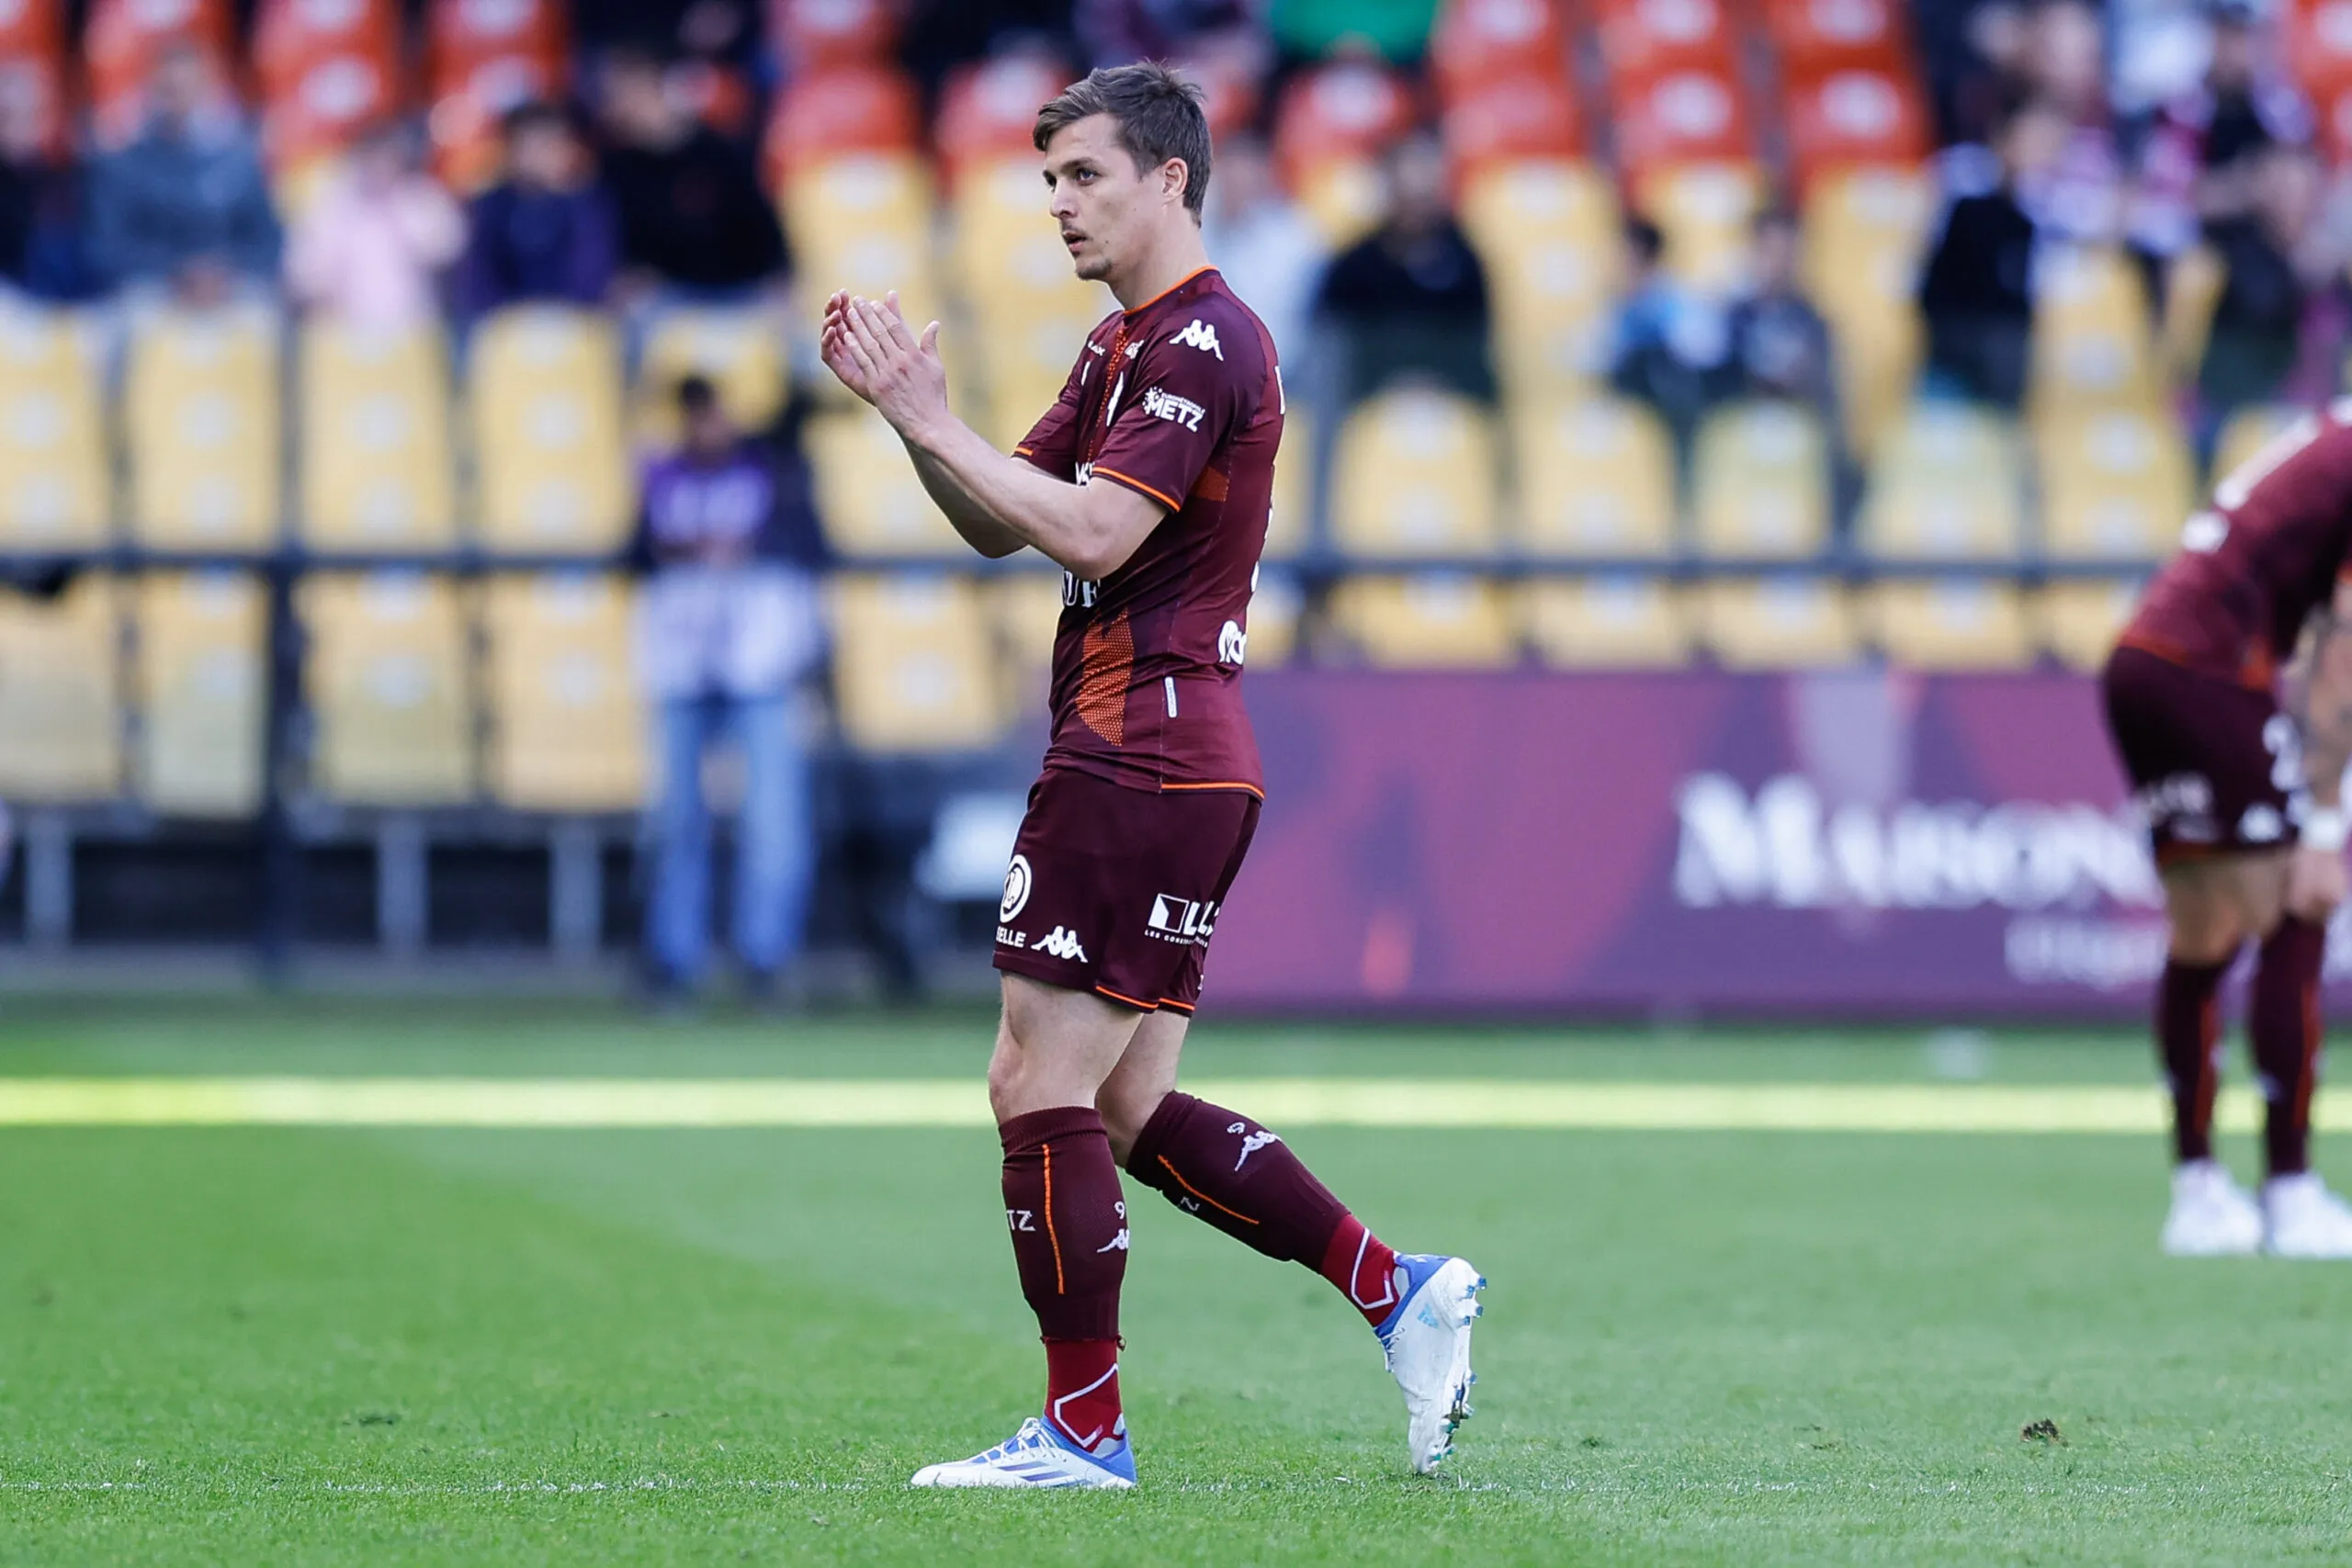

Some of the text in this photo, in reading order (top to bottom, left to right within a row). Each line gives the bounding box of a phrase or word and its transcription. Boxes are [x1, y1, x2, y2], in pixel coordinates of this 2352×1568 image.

[1145, 397, 1204, 433] METZ
[1144, 929, 1160, 939] LES
[1114, 1201, 1125, 1220] 9
